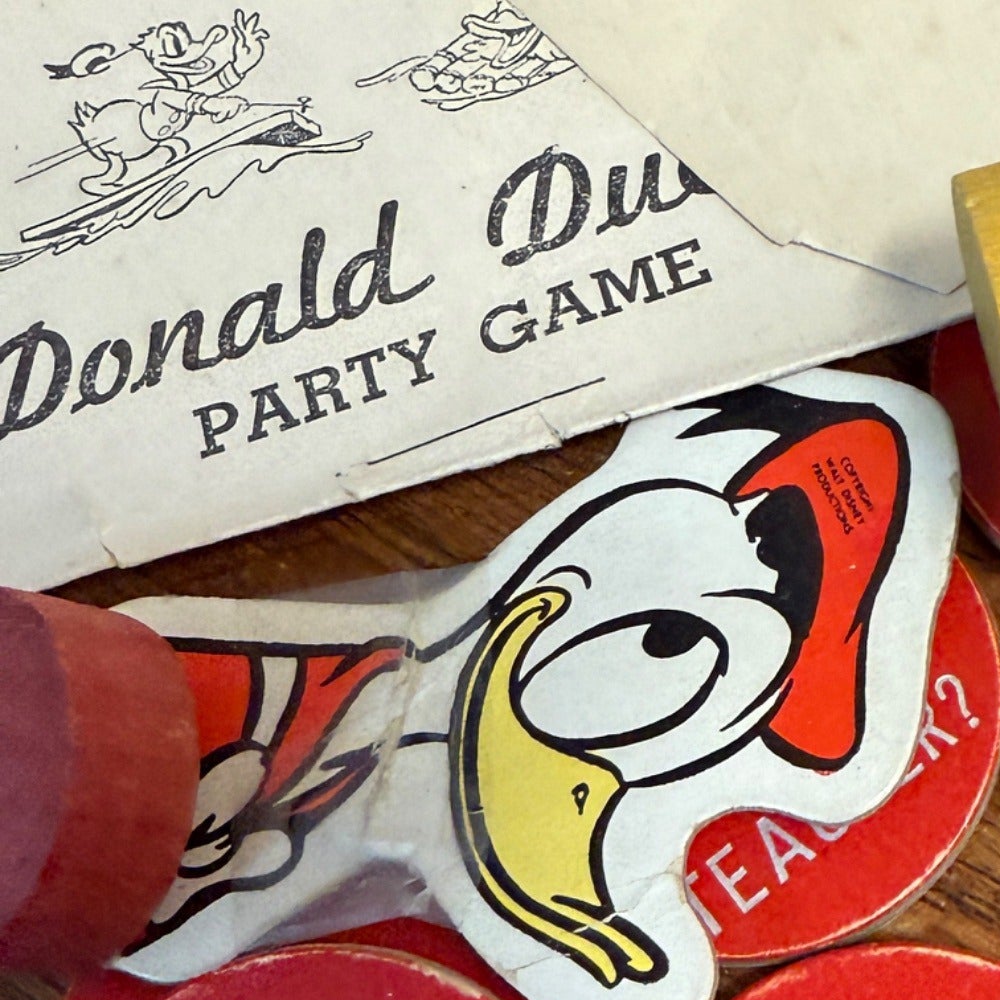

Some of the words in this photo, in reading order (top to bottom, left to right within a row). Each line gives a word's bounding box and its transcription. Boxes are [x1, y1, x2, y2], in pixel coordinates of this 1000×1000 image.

[0, 200, 435, 440] Donald
[193, 329, 438, 458] PARTY
[480, 239, 713, 353] GAME
